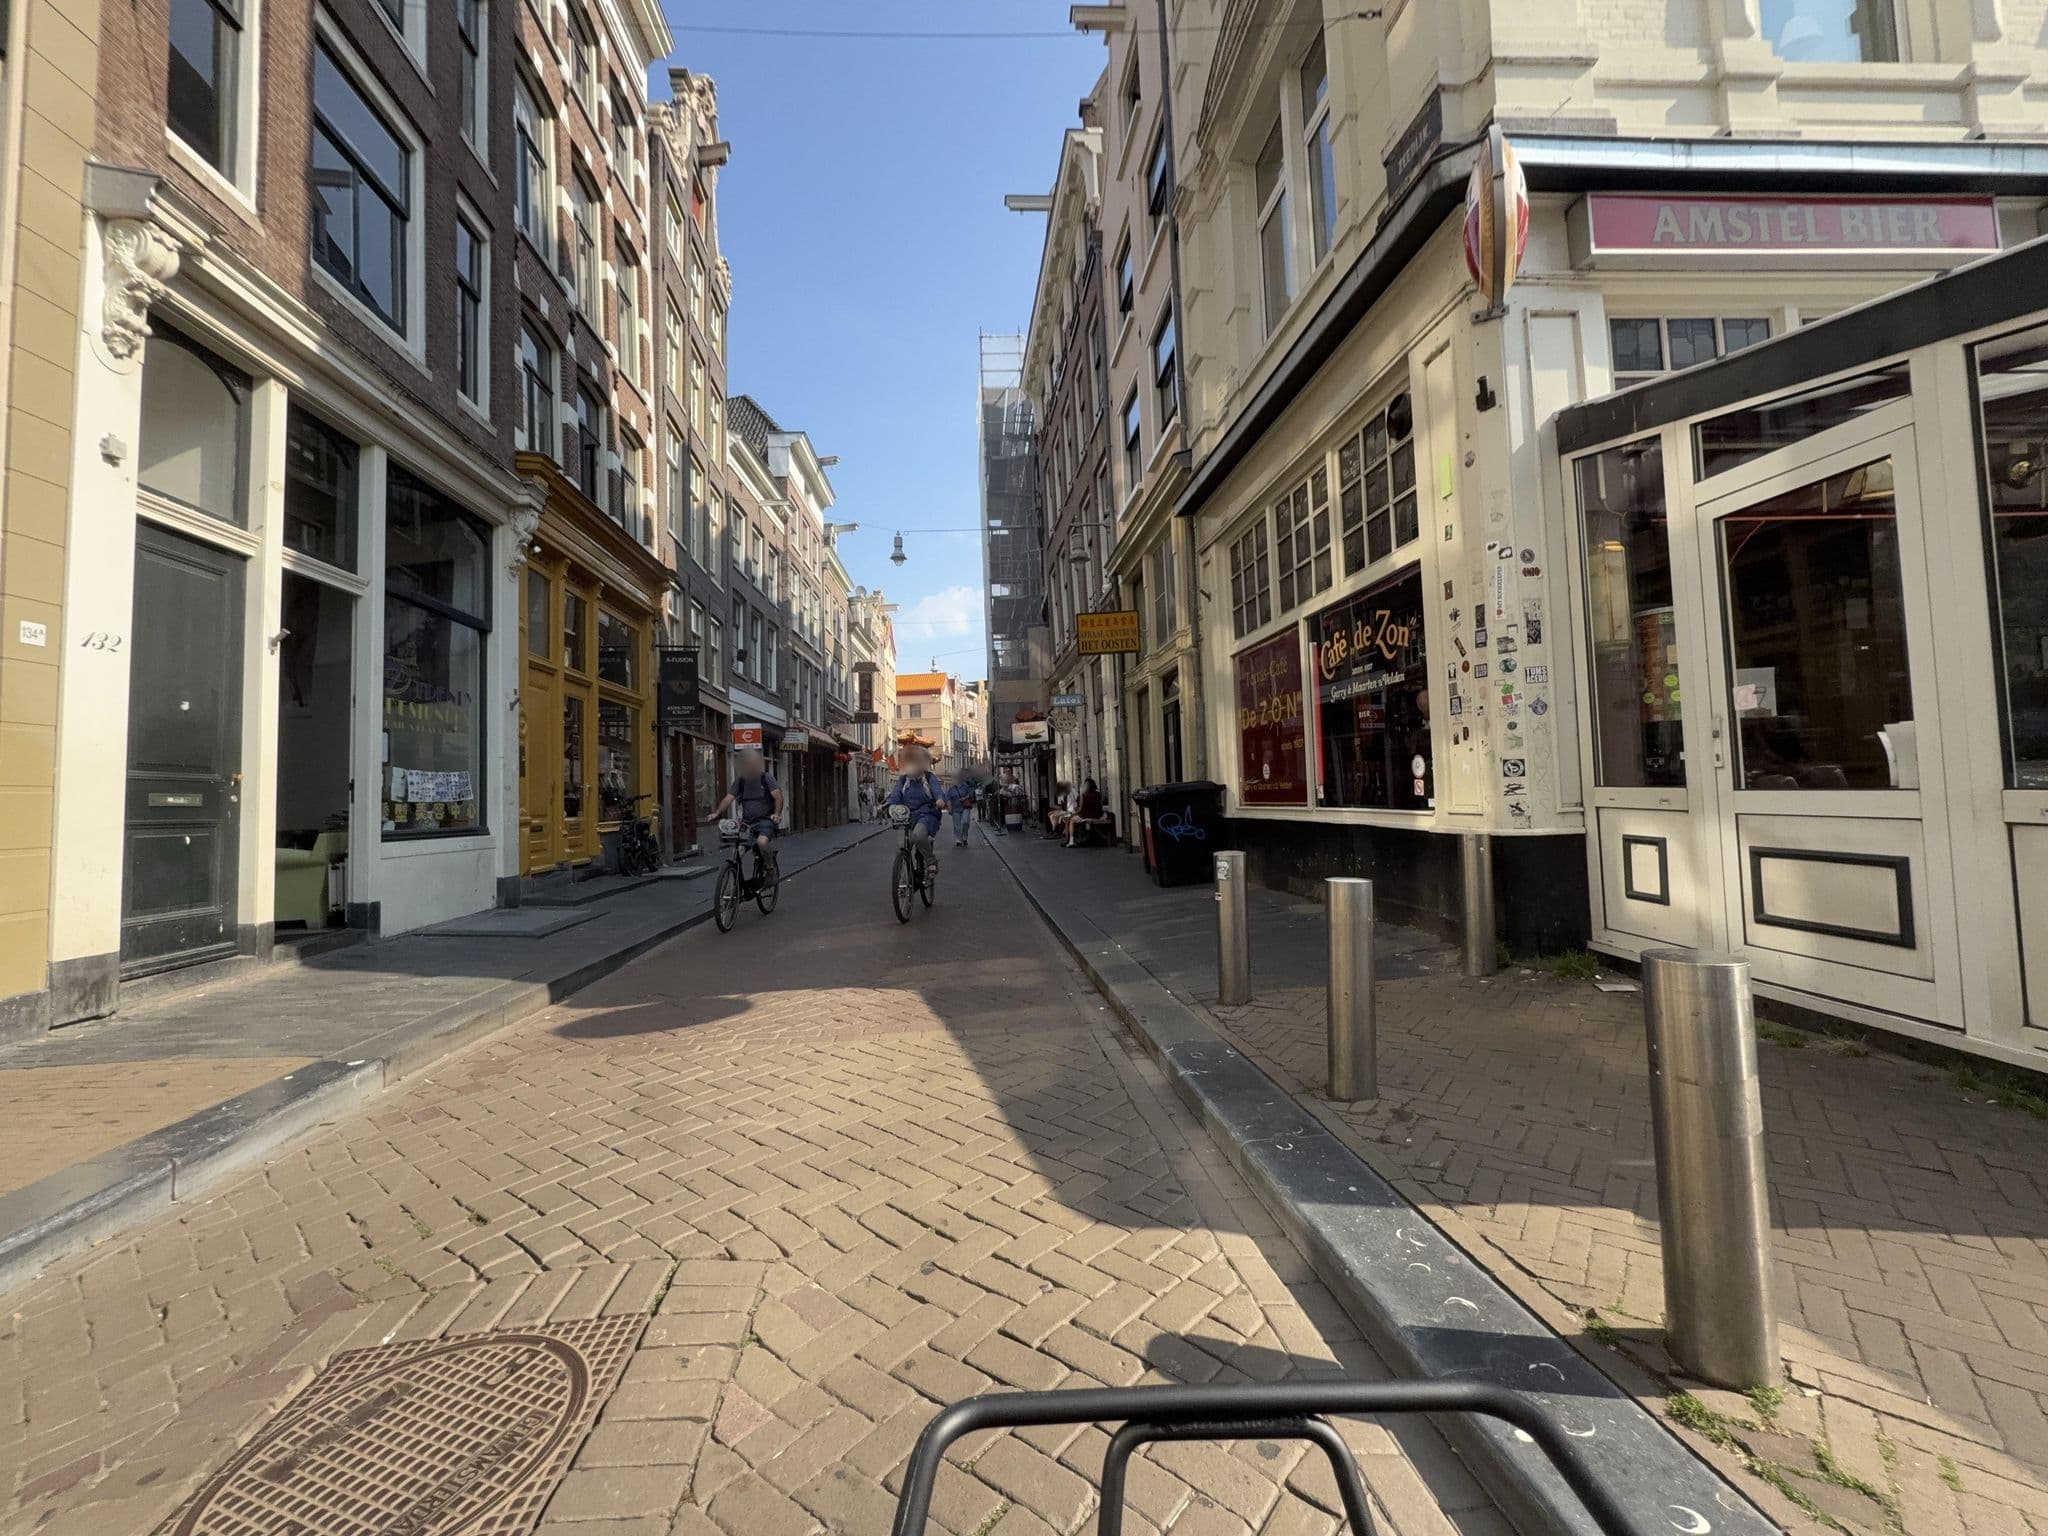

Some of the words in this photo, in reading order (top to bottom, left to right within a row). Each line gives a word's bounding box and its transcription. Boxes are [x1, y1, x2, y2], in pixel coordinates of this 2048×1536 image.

[1653, 204, 1830, 243] AMSTEL
[1838, 205, 1944, 243] BIER
[80, 631, 122, 653] 132
[1081, 640, 1099, 651] HET
[1101, 638, 1137, 650] OOSTEN
[1320, 629, 1348, 680] Café
[378, 1445, 502, 1536] AMSTERDA
